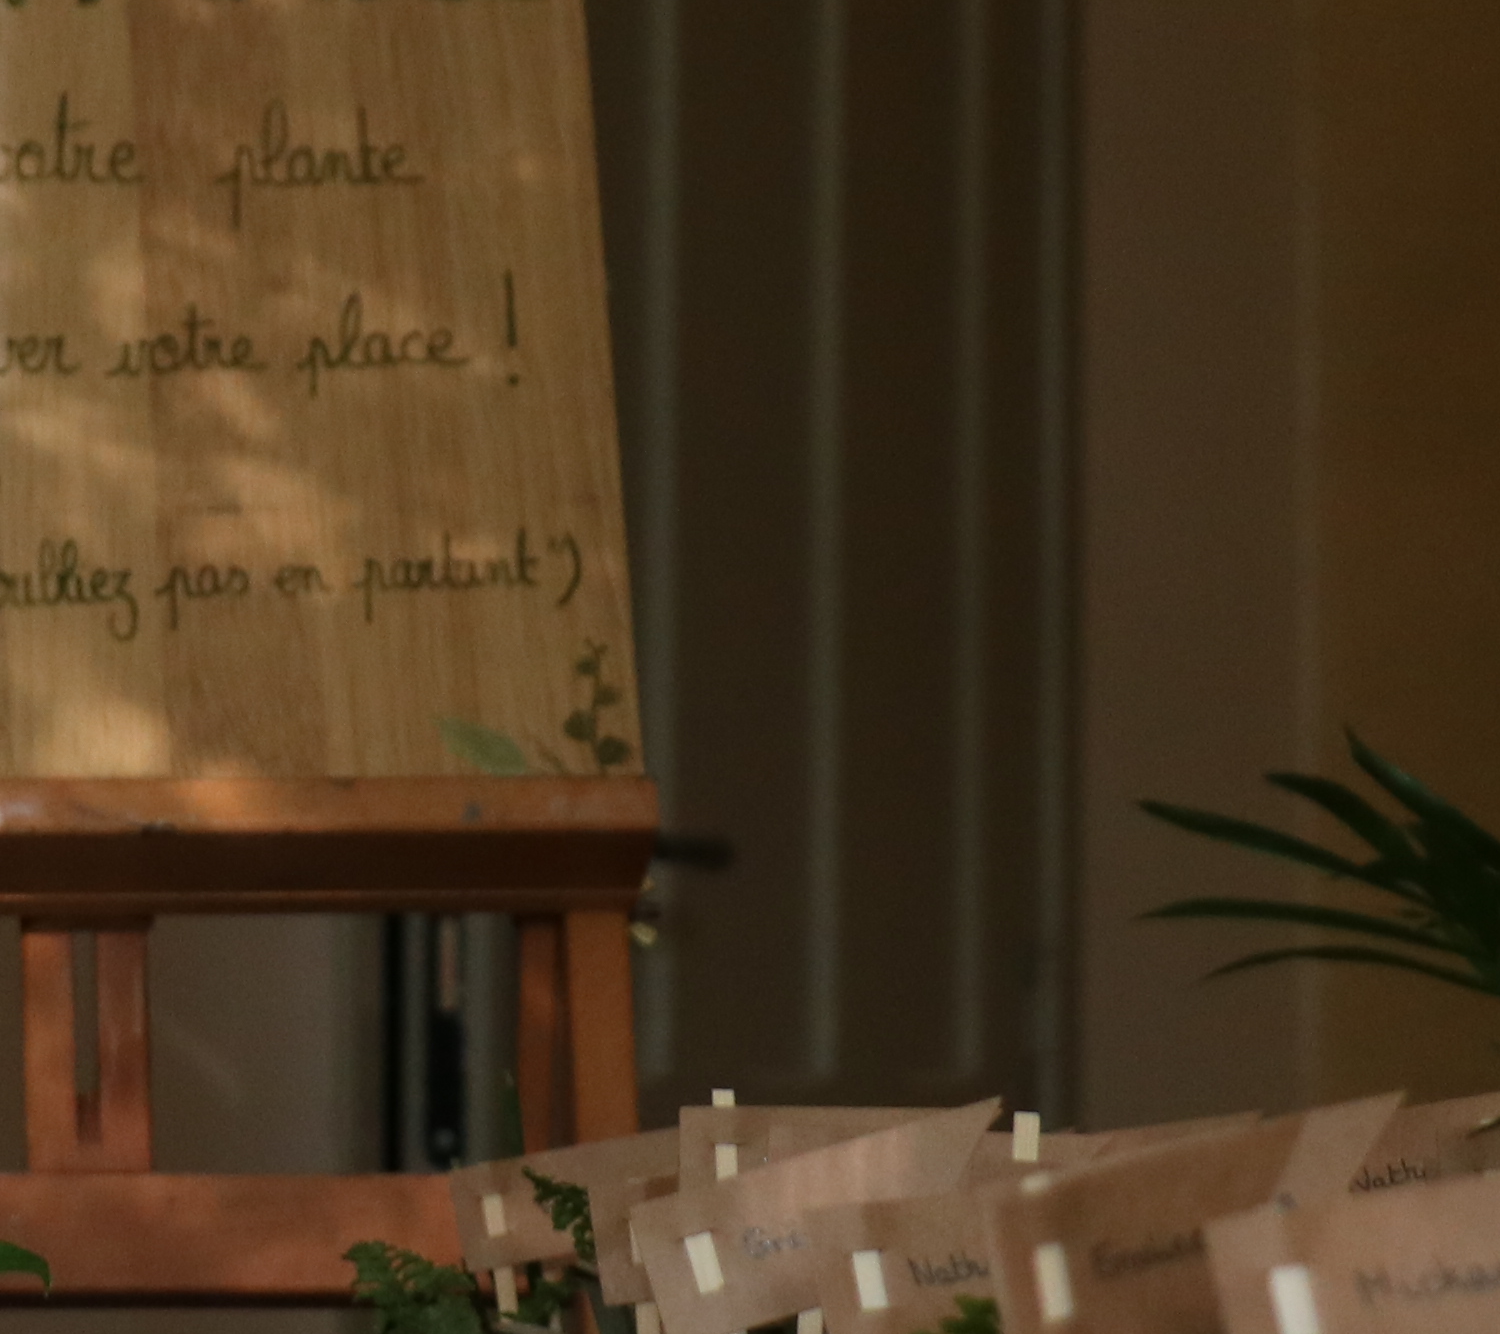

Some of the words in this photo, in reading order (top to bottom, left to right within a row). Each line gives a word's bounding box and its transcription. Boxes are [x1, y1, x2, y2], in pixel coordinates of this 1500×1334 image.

[214, 97, 426, 231] plante
[105, 301, 268, 377] votre
[298, 289, 470, 397] place
[153, 563, 250, 631] pas
[274, 563, 332, 597] en
